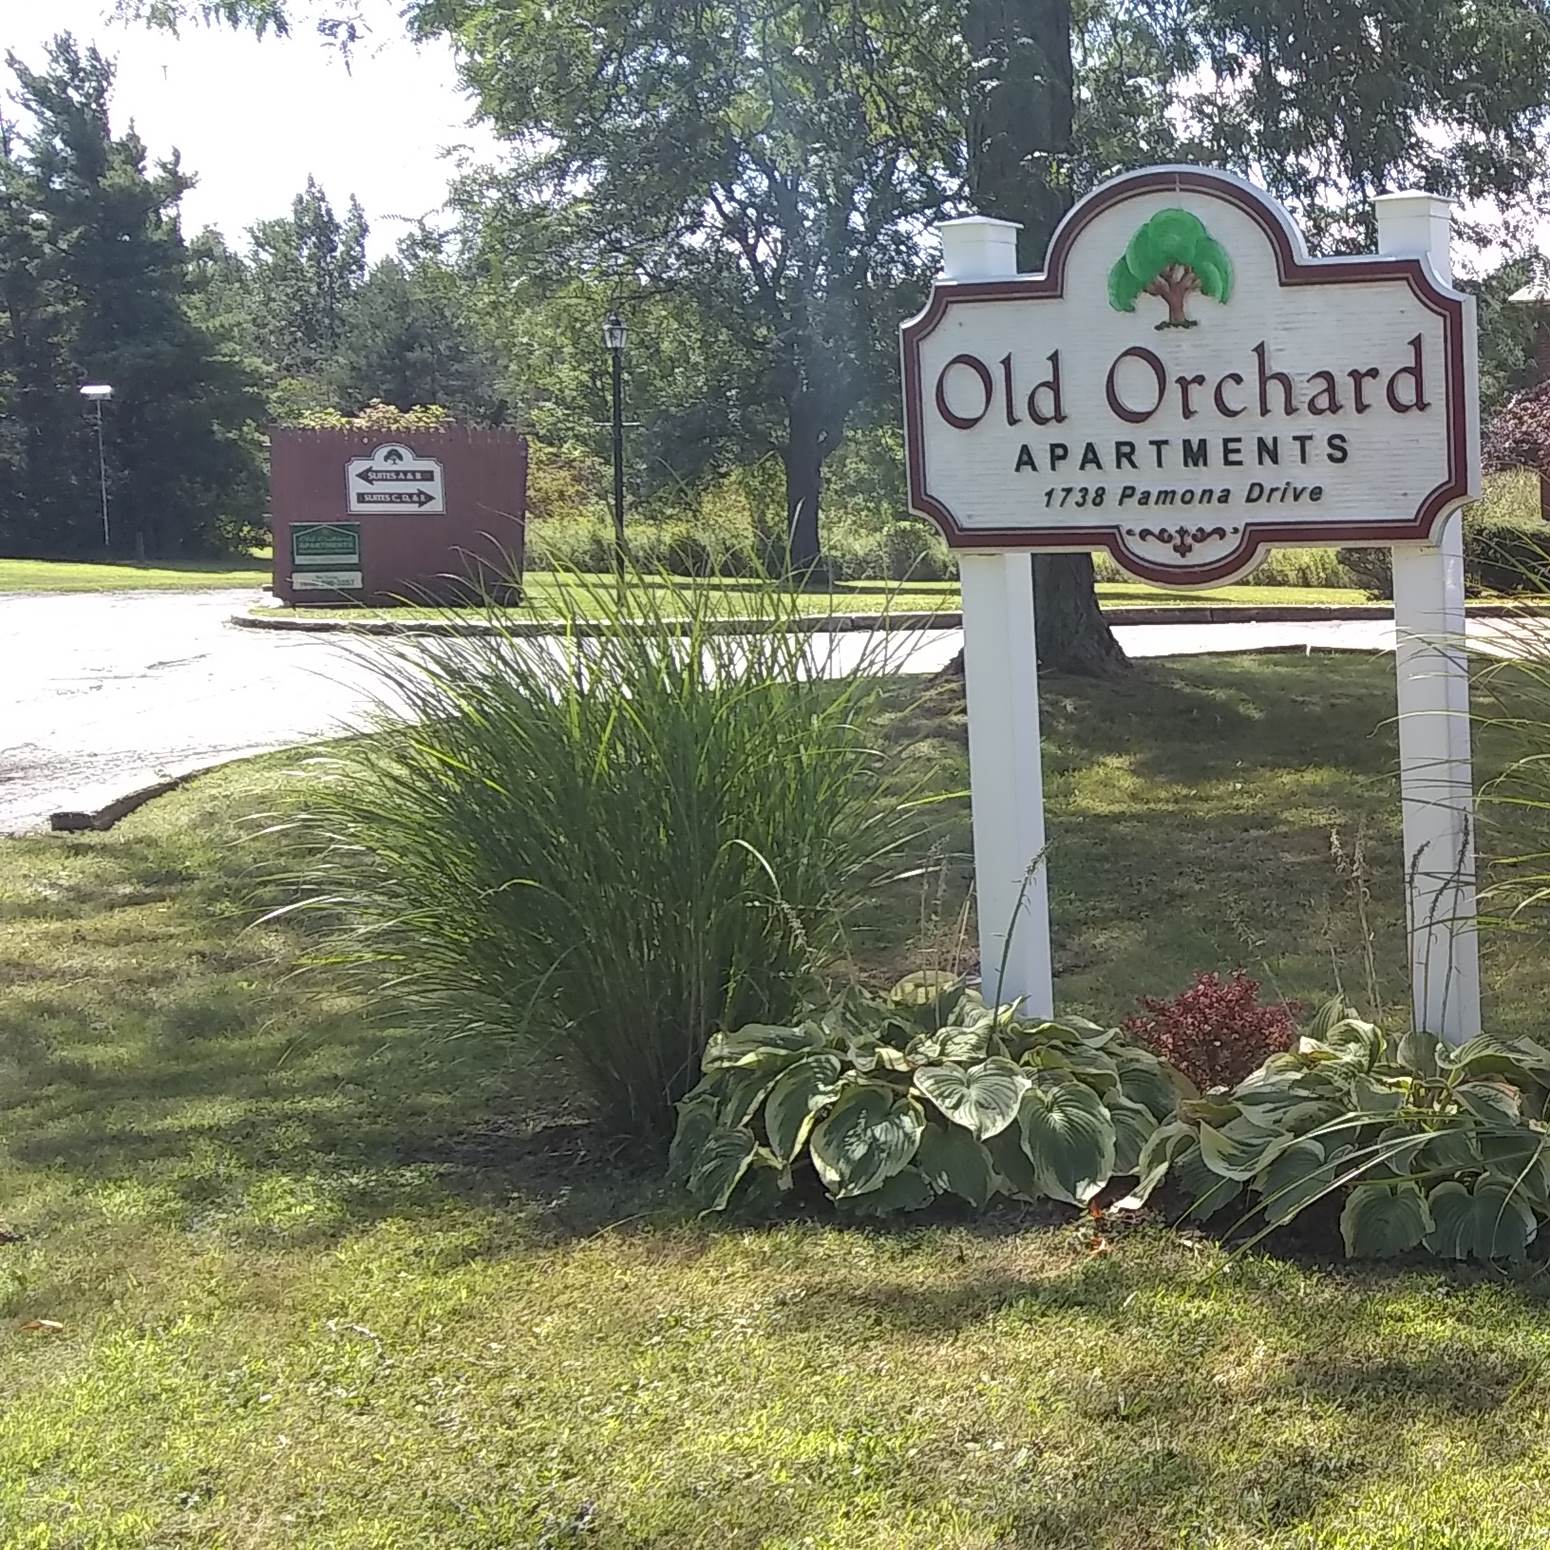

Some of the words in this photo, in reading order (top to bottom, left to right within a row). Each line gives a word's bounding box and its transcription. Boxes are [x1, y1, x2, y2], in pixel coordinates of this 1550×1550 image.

[935, 349, 1068, 430] Old
[1106, 332, 1432, 424] Orchard
[1014, 433, 1350, 473] APARTMENTS
[367, 472, 396, 480] SUITES
[398, 472, 405, 480] A
[406, 472, 414, 480] &
[415, 472, 422, 480] B
[1043, 486, 1106, 509] 1738
[1118, 483, 1231, 507] Pamona
[1247, 482, 1324, 504] Drive
